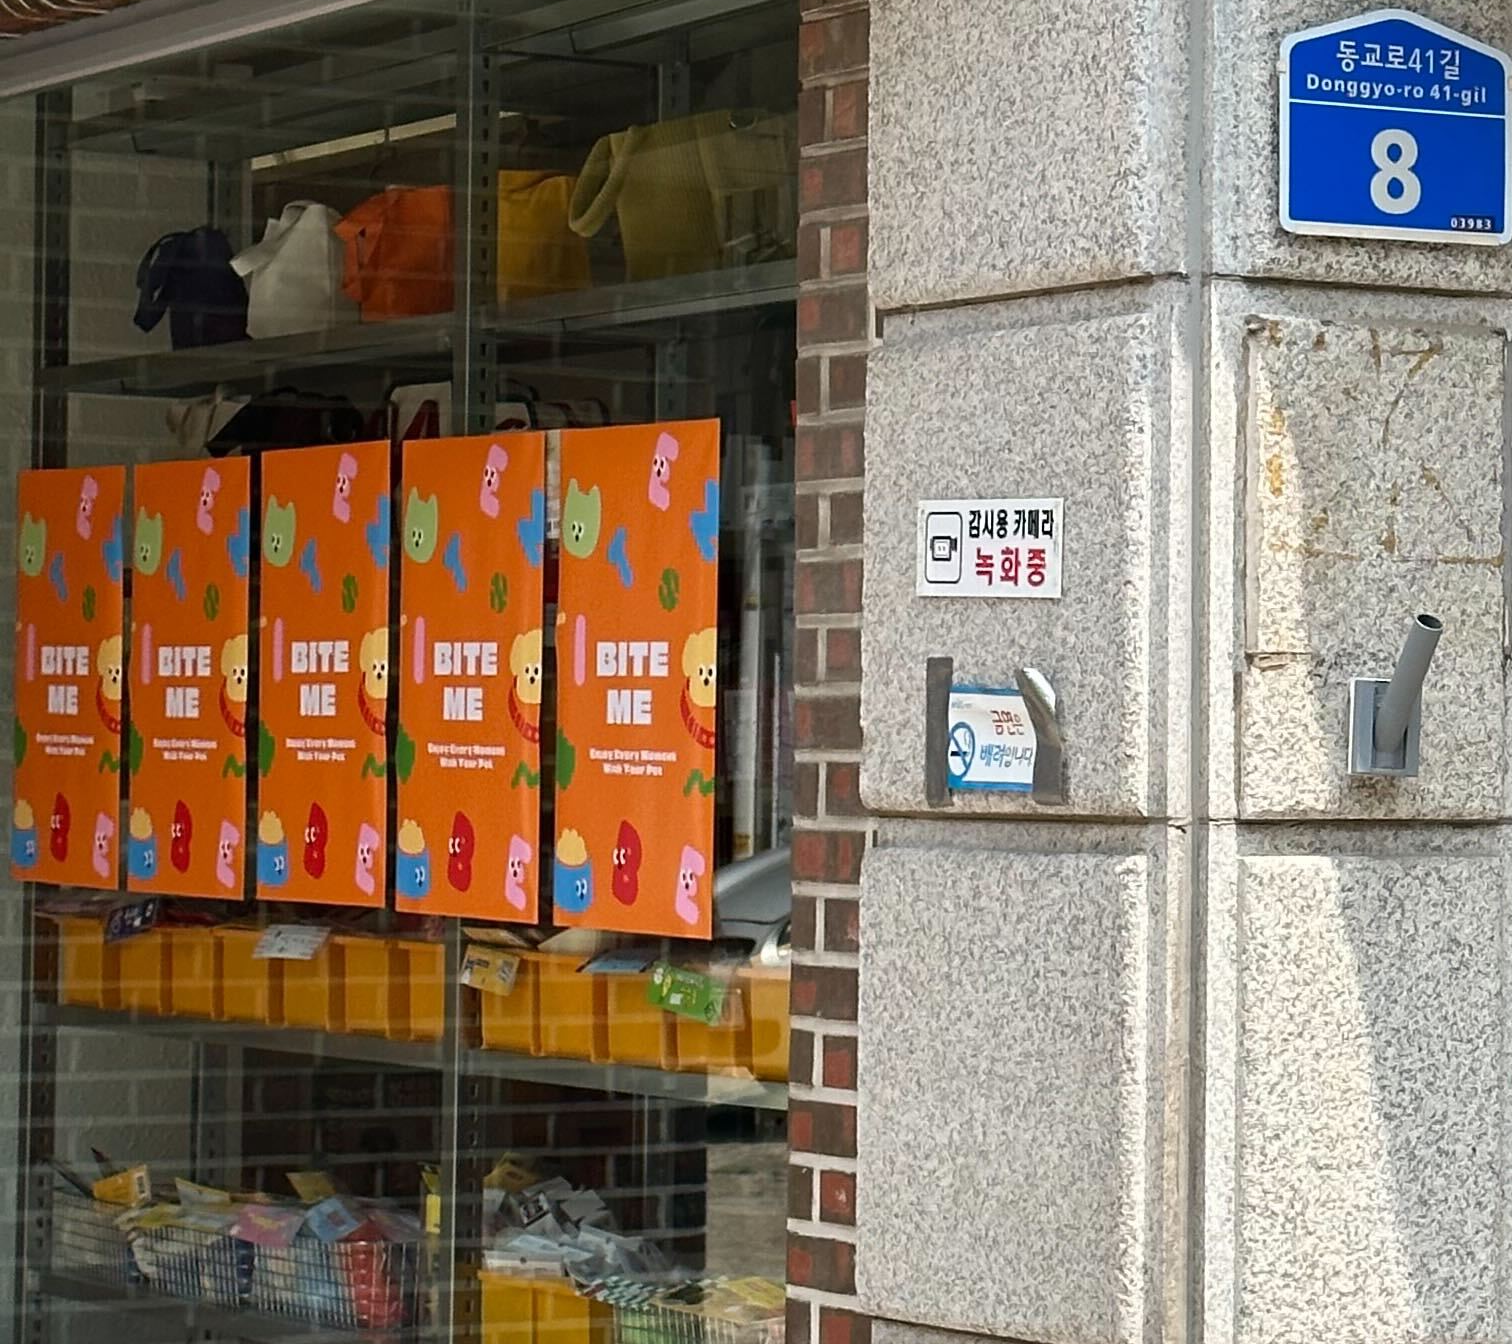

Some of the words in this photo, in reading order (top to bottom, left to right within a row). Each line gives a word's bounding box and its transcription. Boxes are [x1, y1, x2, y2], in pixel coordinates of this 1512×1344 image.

[1336, 40, 1460, 80] 동교로41길
[1306, 73, 1424, 99] Donggyo-ro
[1430, 84, 1487, 107] 41-gil
[1370, 128, 1421, 215] 8
[1450, 217, 1492, 230] 03983
[968, 509, 1009, 539] 감시용
[1013, 509, 1054, 539] 카메라
[41, 646, 89, 676] BITE
[158, 646, 211, 677] BITE
[291, 640, 349, 673] BITE
[433, 641, 498, 676] BITE
[596, 641, 669, 677] BITE
[48, 685, 78, 715] ME
[165, 687, 199, 718] ME
[300, 684, 336, 716] ME
[443, 687, 483, 721] ME
[606, 689, 652, 725] ME
